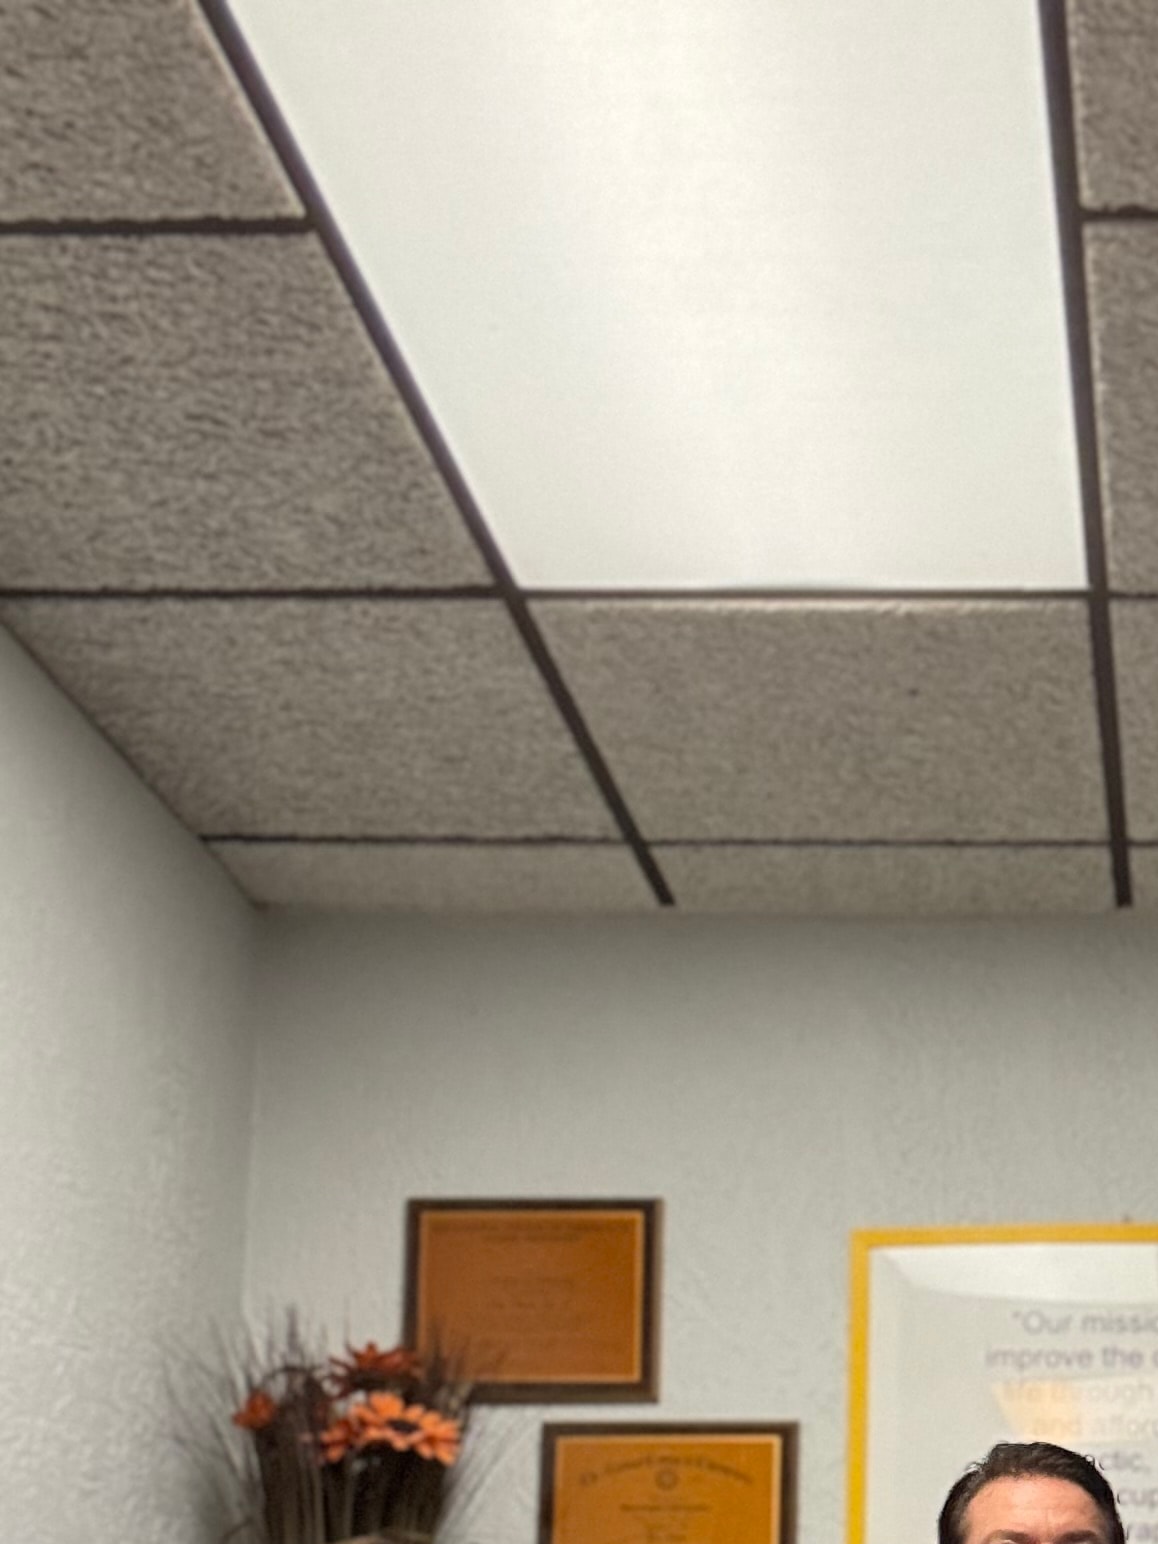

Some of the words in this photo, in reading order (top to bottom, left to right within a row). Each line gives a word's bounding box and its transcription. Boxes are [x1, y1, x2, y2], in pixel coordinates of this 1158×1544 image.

[1011, 1310, 1073, 1335] "Our
[985, 1348, 1094, 1371] improve
[1102, 1346, 1144, 1368] the
